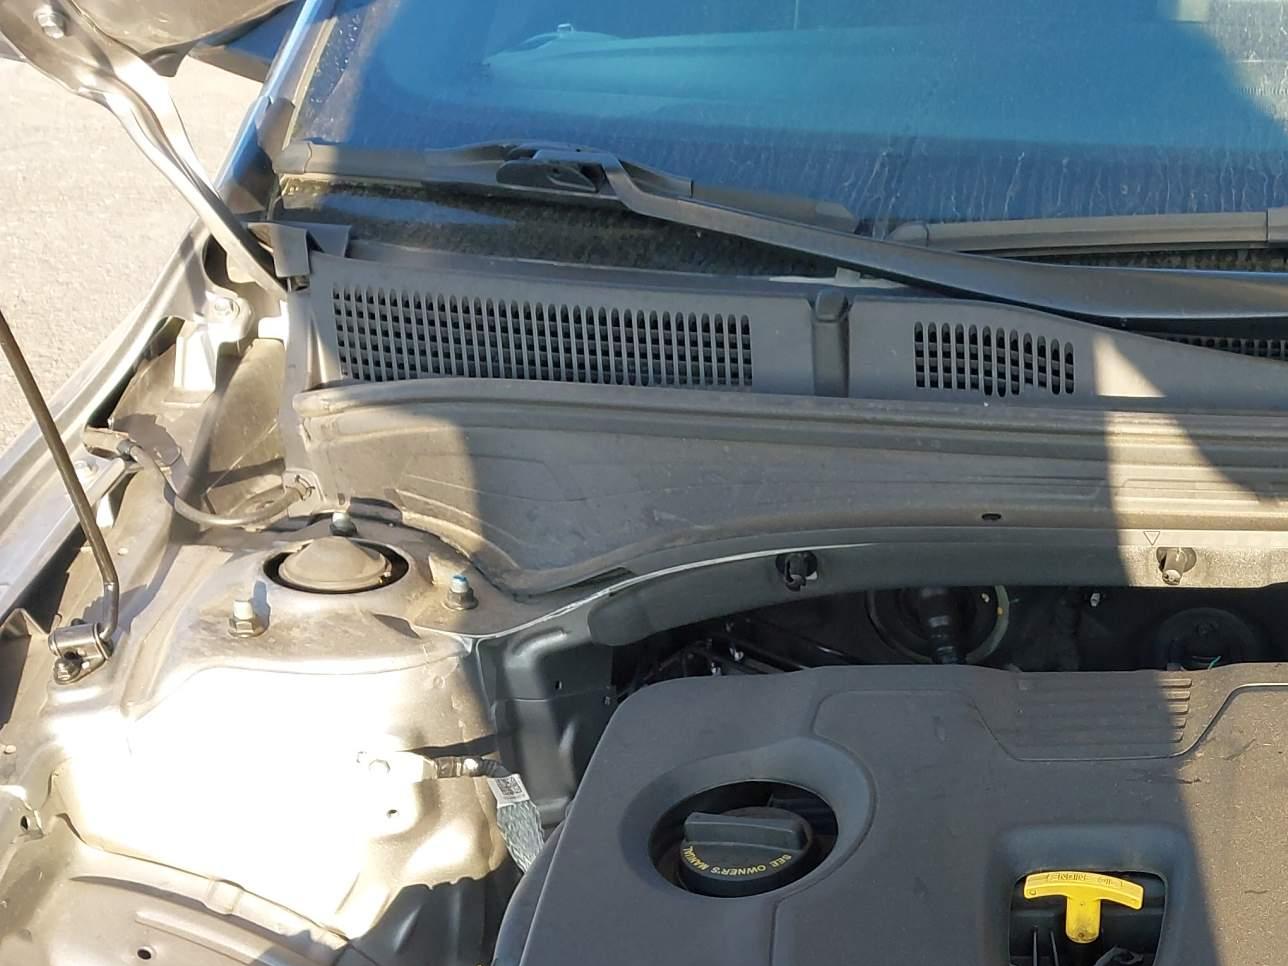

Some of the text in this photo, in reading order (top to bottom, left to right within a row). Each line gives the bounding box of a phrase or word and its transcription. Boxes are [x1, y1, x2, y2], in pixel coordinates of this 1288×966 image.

[683, 846, 792, 876] SEE OWNER'S MANUAL
